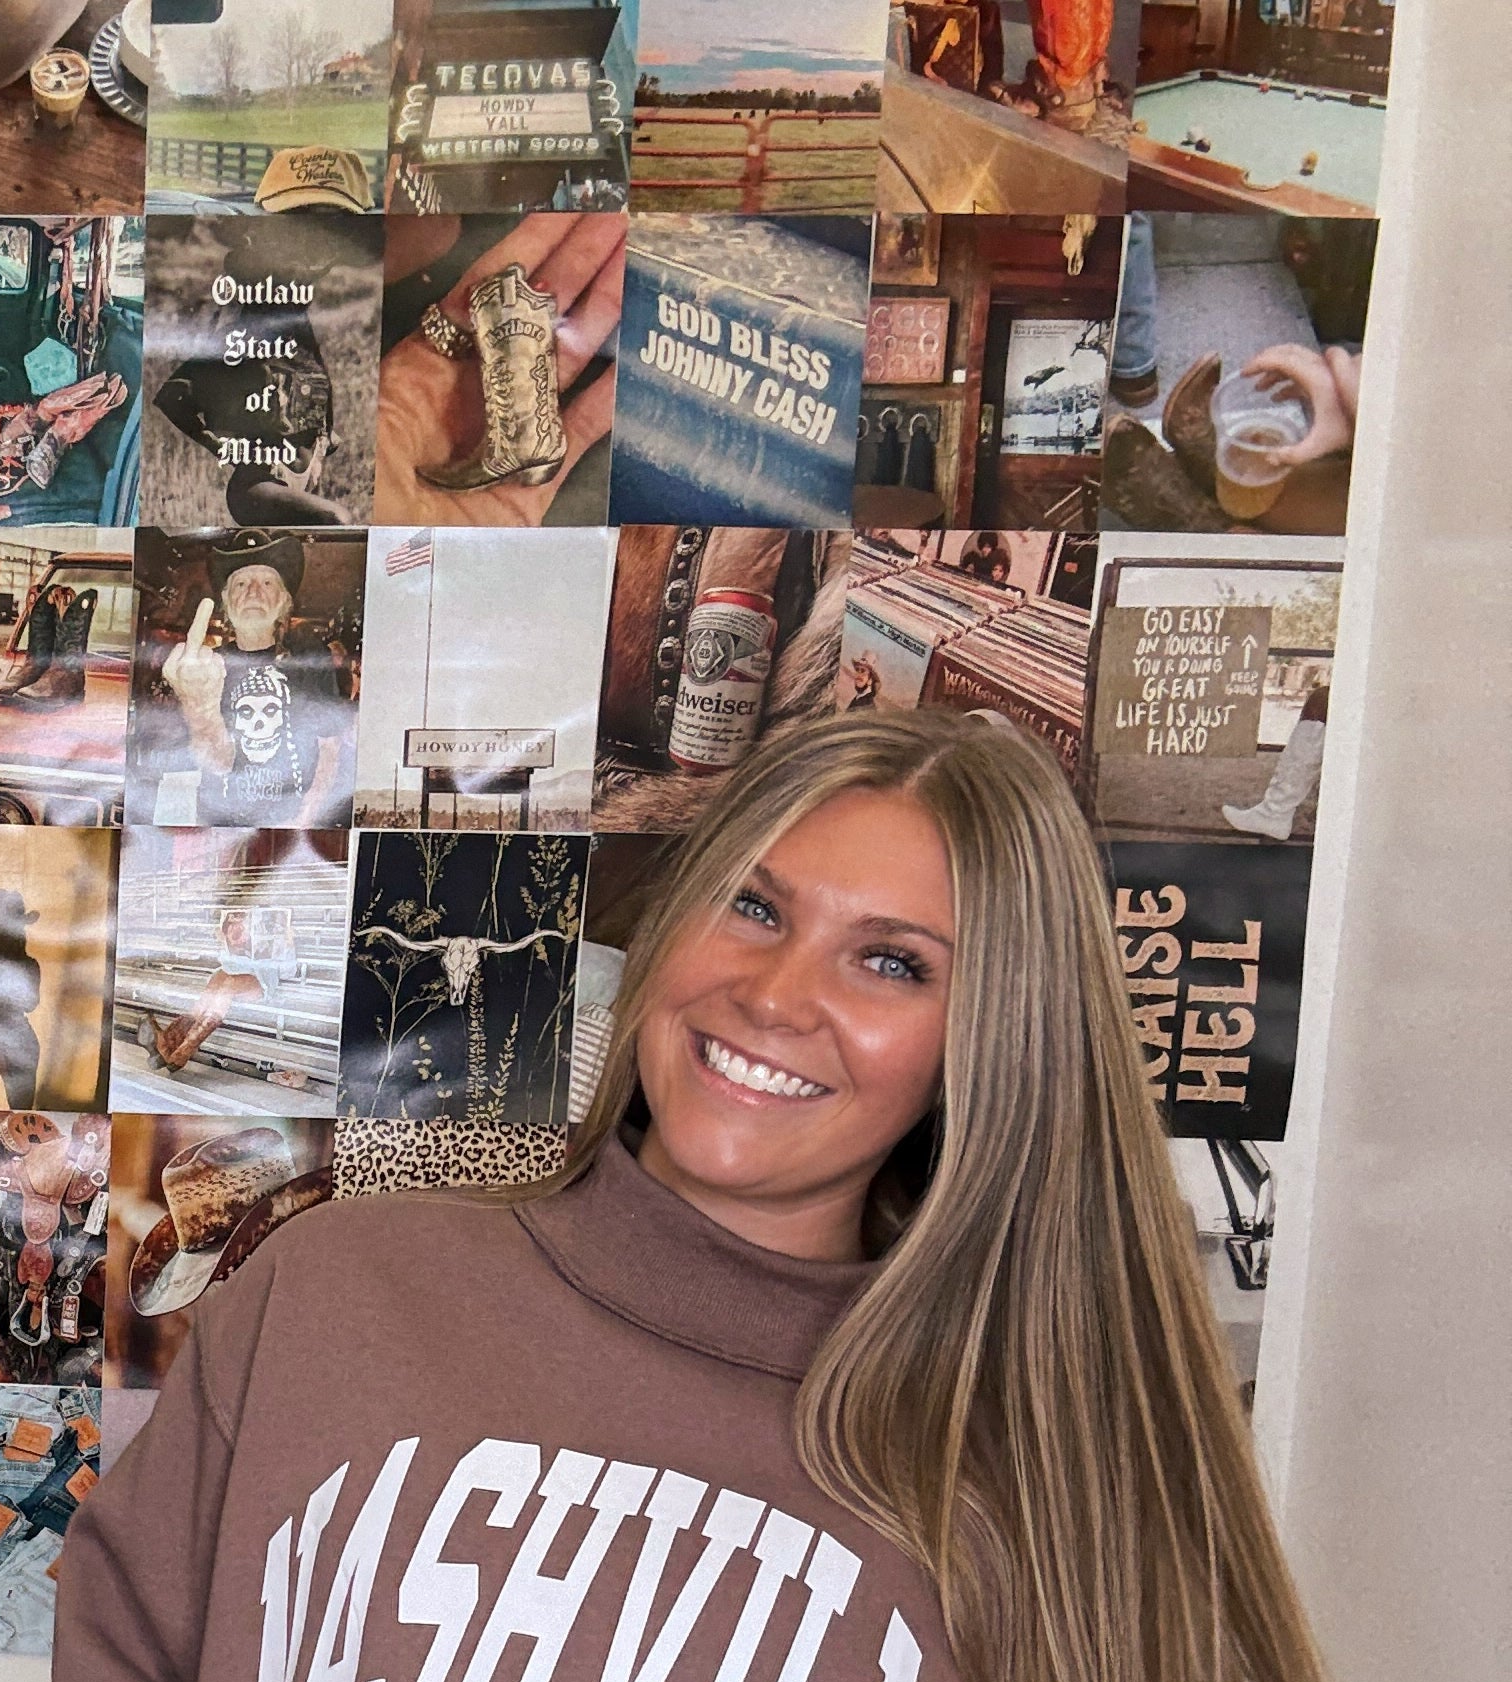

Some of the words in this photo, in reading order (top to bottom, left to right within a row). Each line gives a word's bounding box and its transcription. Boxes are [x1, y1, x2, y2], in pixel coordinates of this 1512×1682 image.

[435, 61, 591, 91] TECOVAS
[480, 98, 536, 113] HOWDY
[423, 139, 521, 158] WESTERN
[530, 137, 599, 156] GOODS
[212, 274, 315, 306] Outlaw
[223, 328, 299, 367] State
[658, 293, 722, 347] GOD
[729, 320, 833, 390] BLESS
[245, 383, 278, 413] of
[640, 330, 754, 404] JOHNNY
[753, 378, 838, 444] CASH
[217, 436, 298, 468] Mind
[1143, 607, 1173, 634] GO
[1179, 607, 1225, 634] EASY
[1136, 636, 1160, 656] ON
[1164, 633, 1231, 656] YOURSELF
[1179, 657, 1224, 675] DOING
[1230, 671, 1259, 683] KEEP
[678, 687, 757, 716] dweiser
[1142, 676, 1211, 701] GREAT
[1116, 698, 1161, 729] LIFE
[1166, 702, 1187, 728] IS
[1190, 704, 1237, 729] JUST
[416, 742, 482, 753] HOWDY
[484, 741, 547, 753] HONEY
[1146, 726, 1208, 756] HARD
[1175, 919, 1262, 1104] HELL
